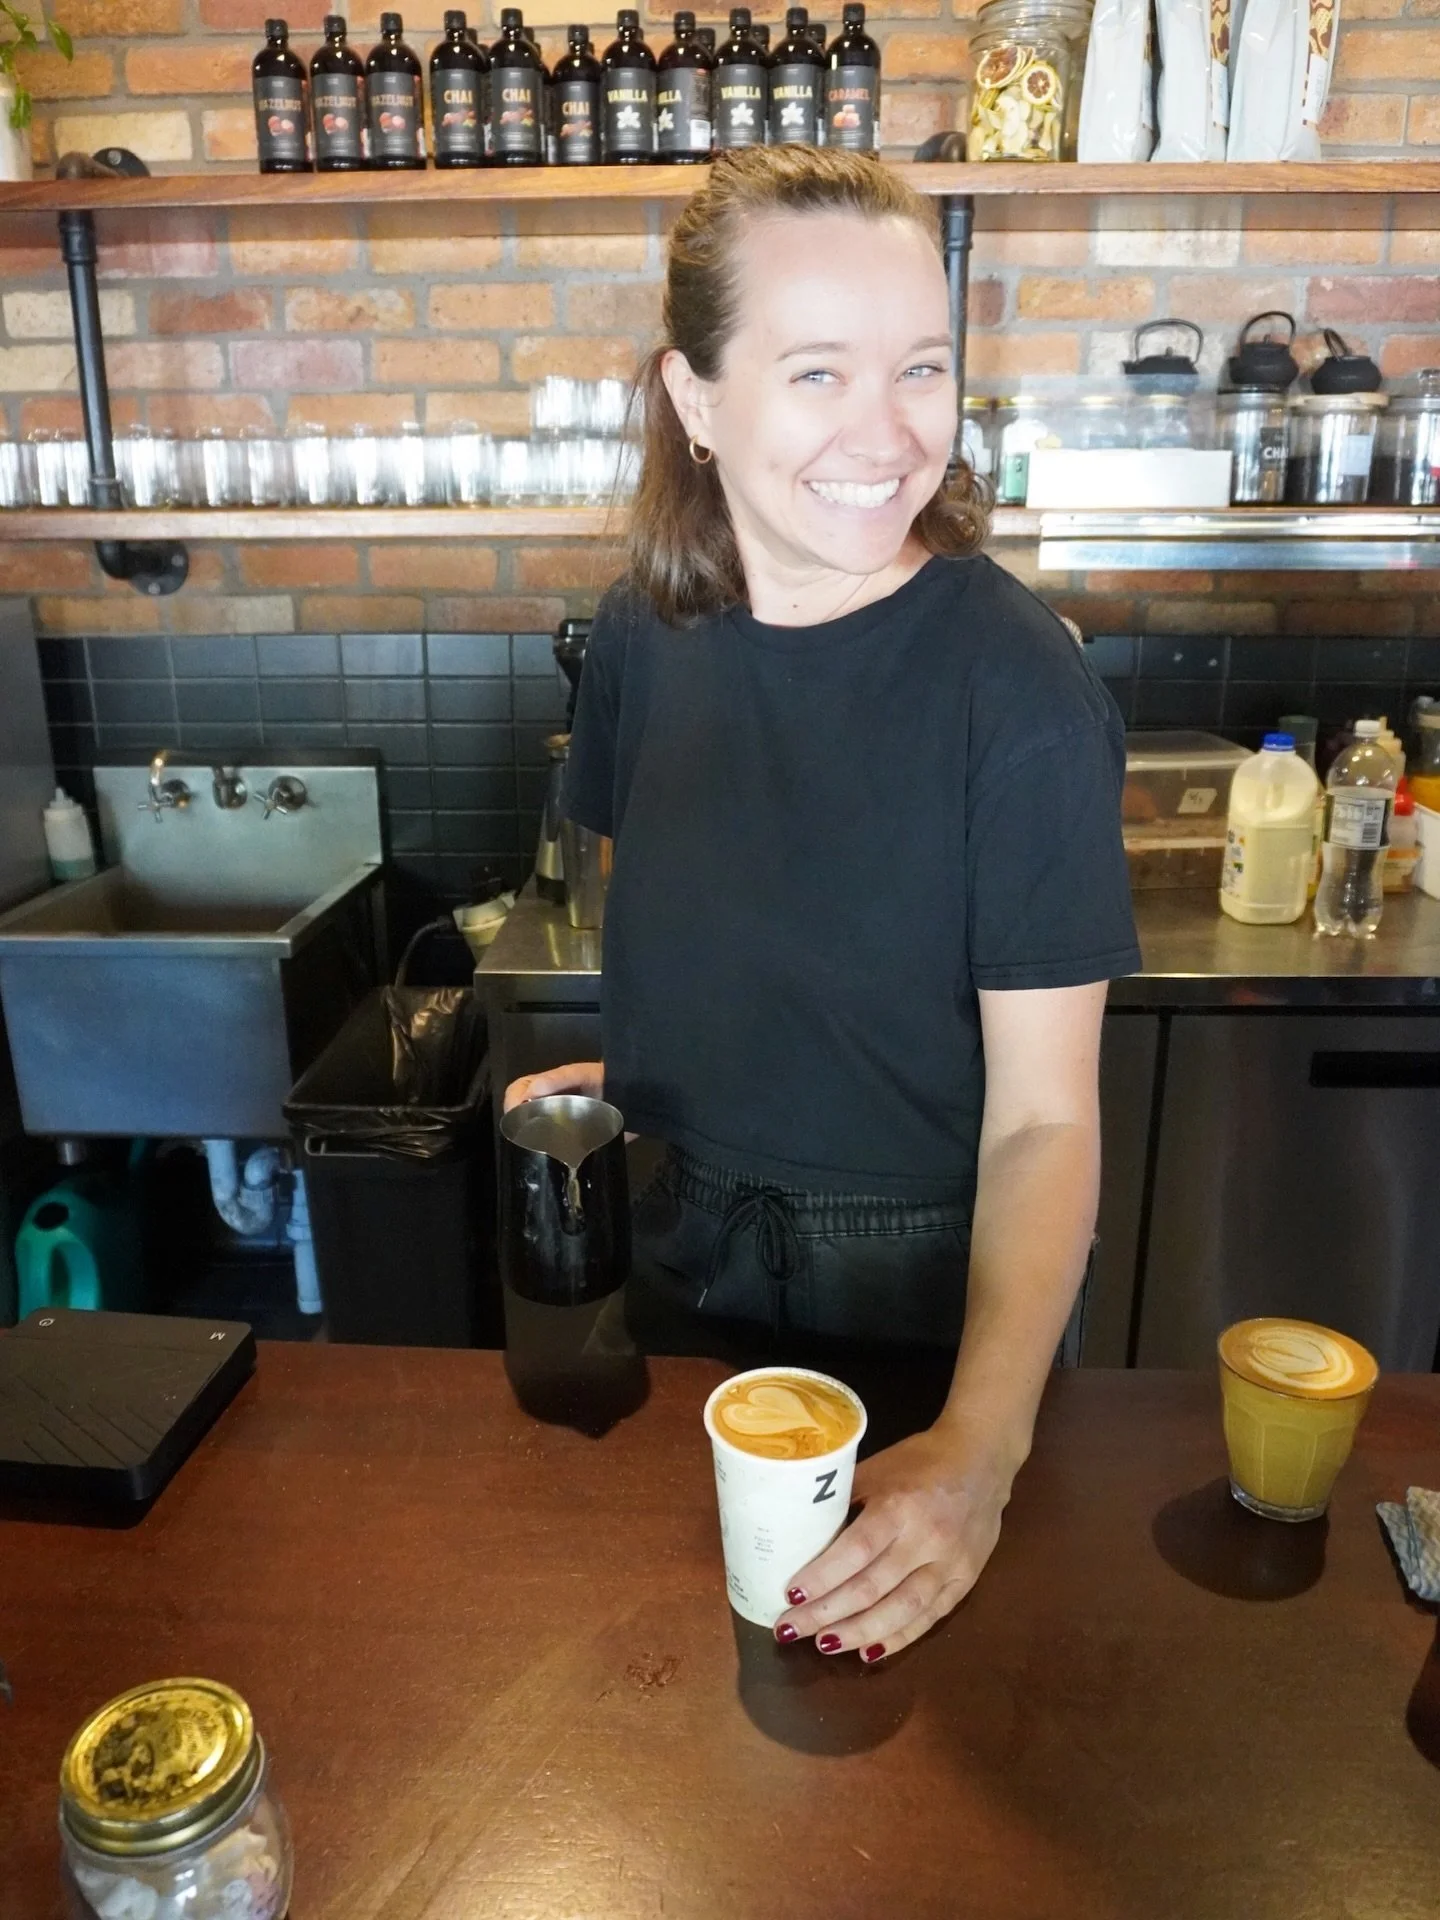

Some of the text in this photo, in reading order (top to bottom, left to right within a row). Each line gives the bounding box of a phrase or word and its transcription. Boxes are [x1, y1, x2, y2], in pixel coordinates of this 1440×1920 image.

[443, 89, 473, 104] CHAI
[502, 87, 532, 103] CHAI
[607, 88, 648, 104] VANILLA
[720, 85, 761, 100] VANILLA
[772, 85, 813, 100] VANILLA
[827, 87, 871, 103] CARAMEL
[562, 101, 590, 116] CHAI
[813, 1469, 838, 1504] Z
